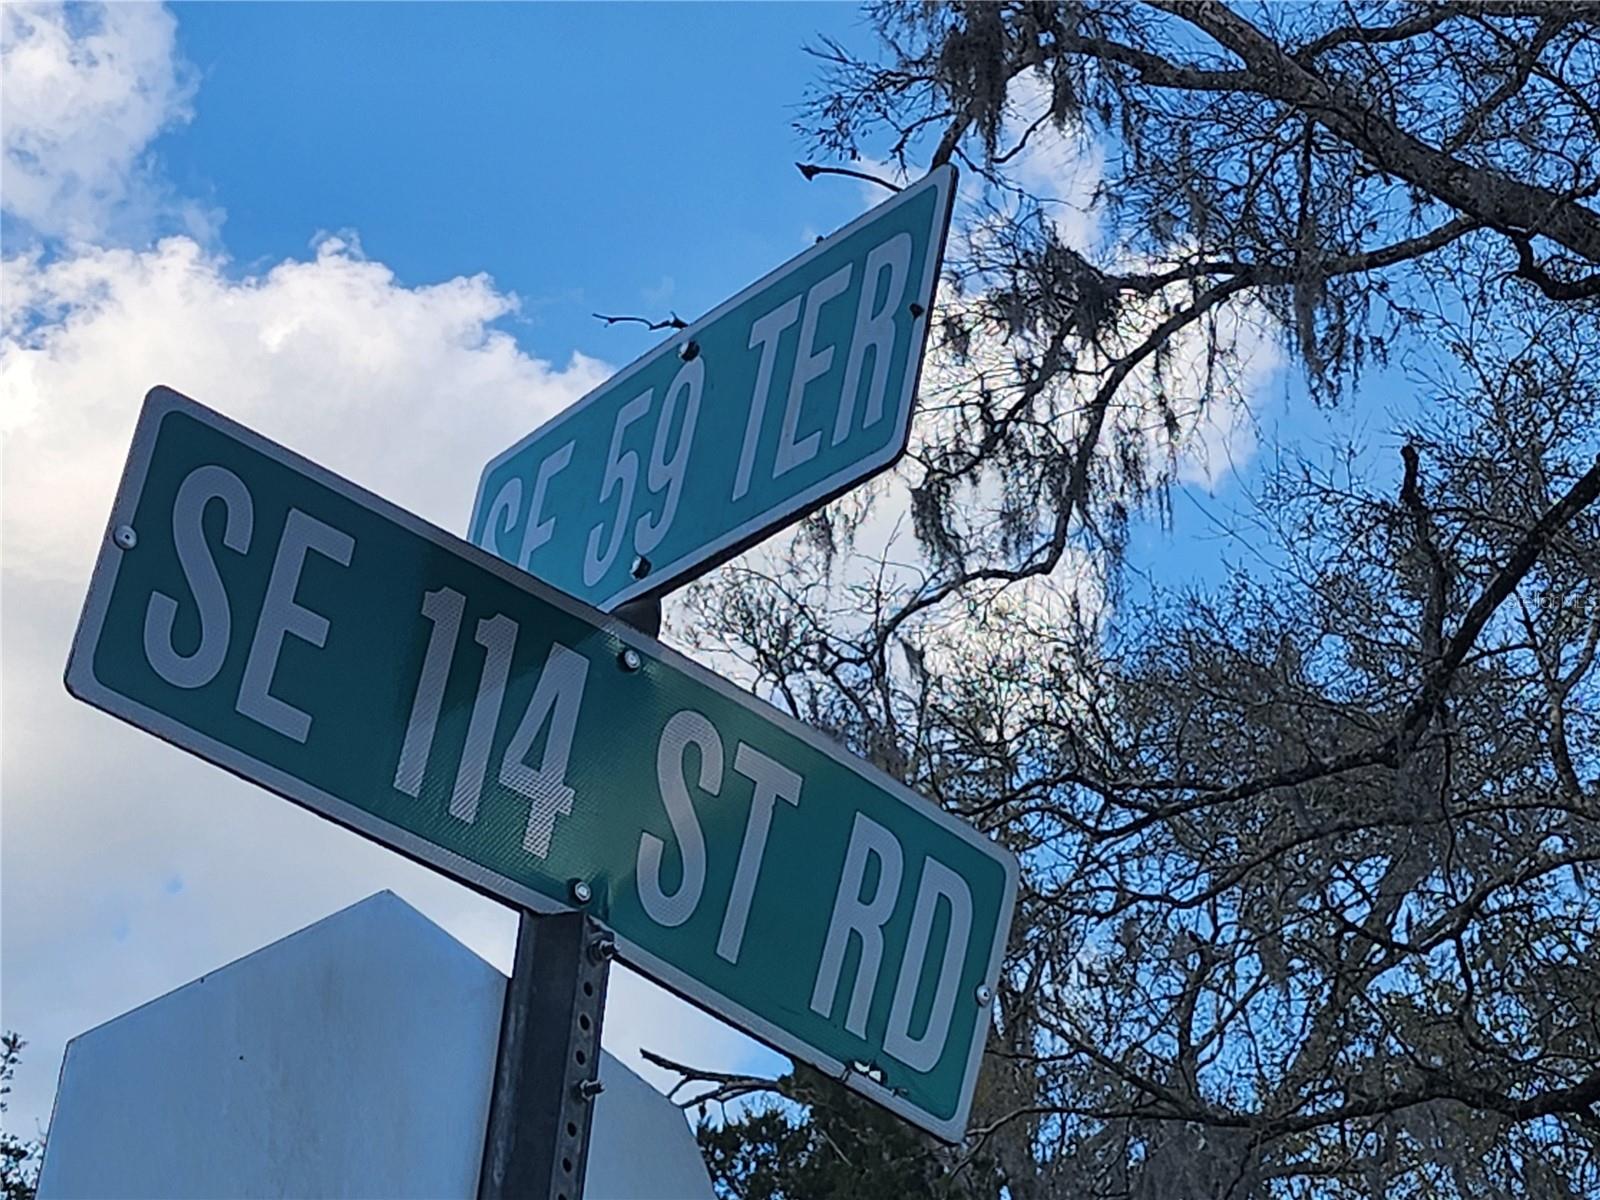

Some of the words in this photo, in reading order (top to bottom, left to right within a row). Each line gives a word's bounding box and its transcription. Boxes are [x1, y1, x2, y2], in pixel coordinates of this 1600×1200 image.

[583, 355, 706, 588] 59
[731, 232, 913, 502] TER
[143, 465, 356, 744] SE
[393, 585, 590, 860] 114
[636, 709, 803, 965] ST
[810, 811, 974, 1073] RD
